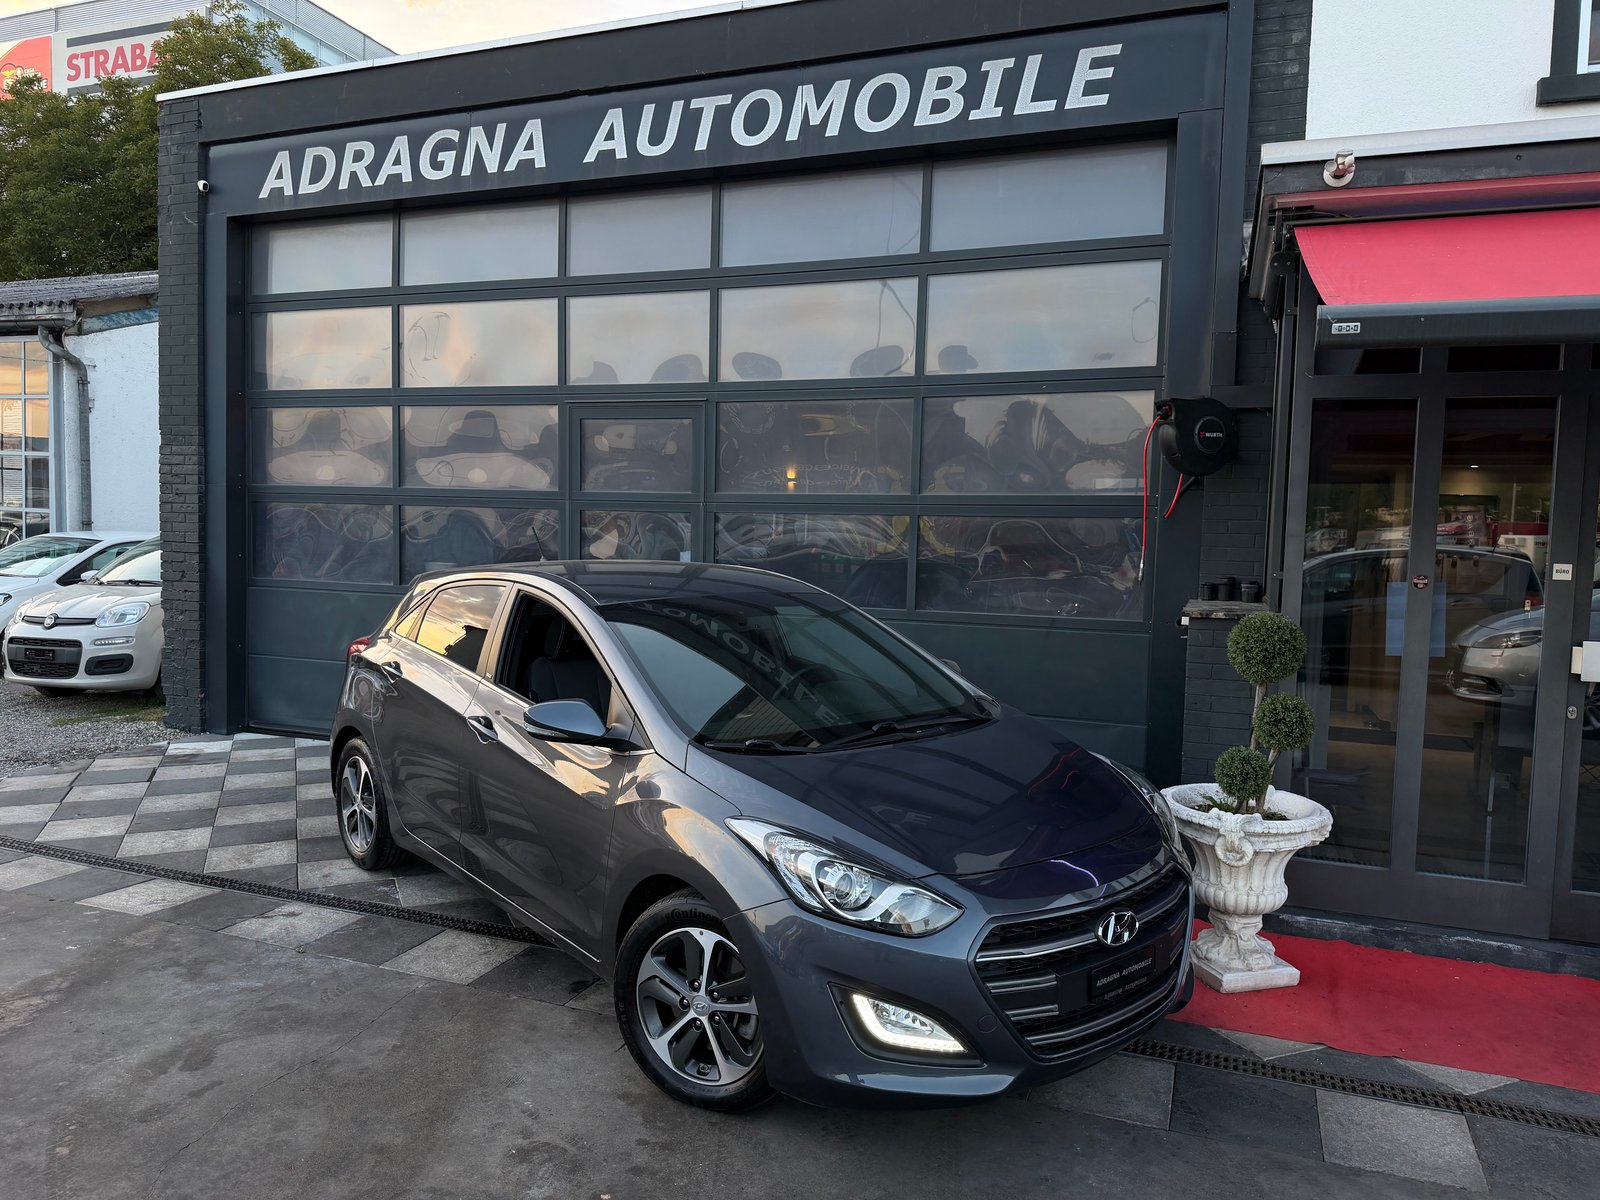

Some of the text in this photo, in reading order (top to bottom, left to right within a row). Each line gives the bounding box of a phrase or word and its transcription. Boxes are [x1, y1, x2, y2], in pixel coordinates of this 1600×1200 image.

[66, 40, 165, 82] STRABA
[258, 43, 1123, 199] ADRAGNA AUTOMOBILE
[1096, 957, 1152, 987] ADRAGNA AUTOMOBILE
